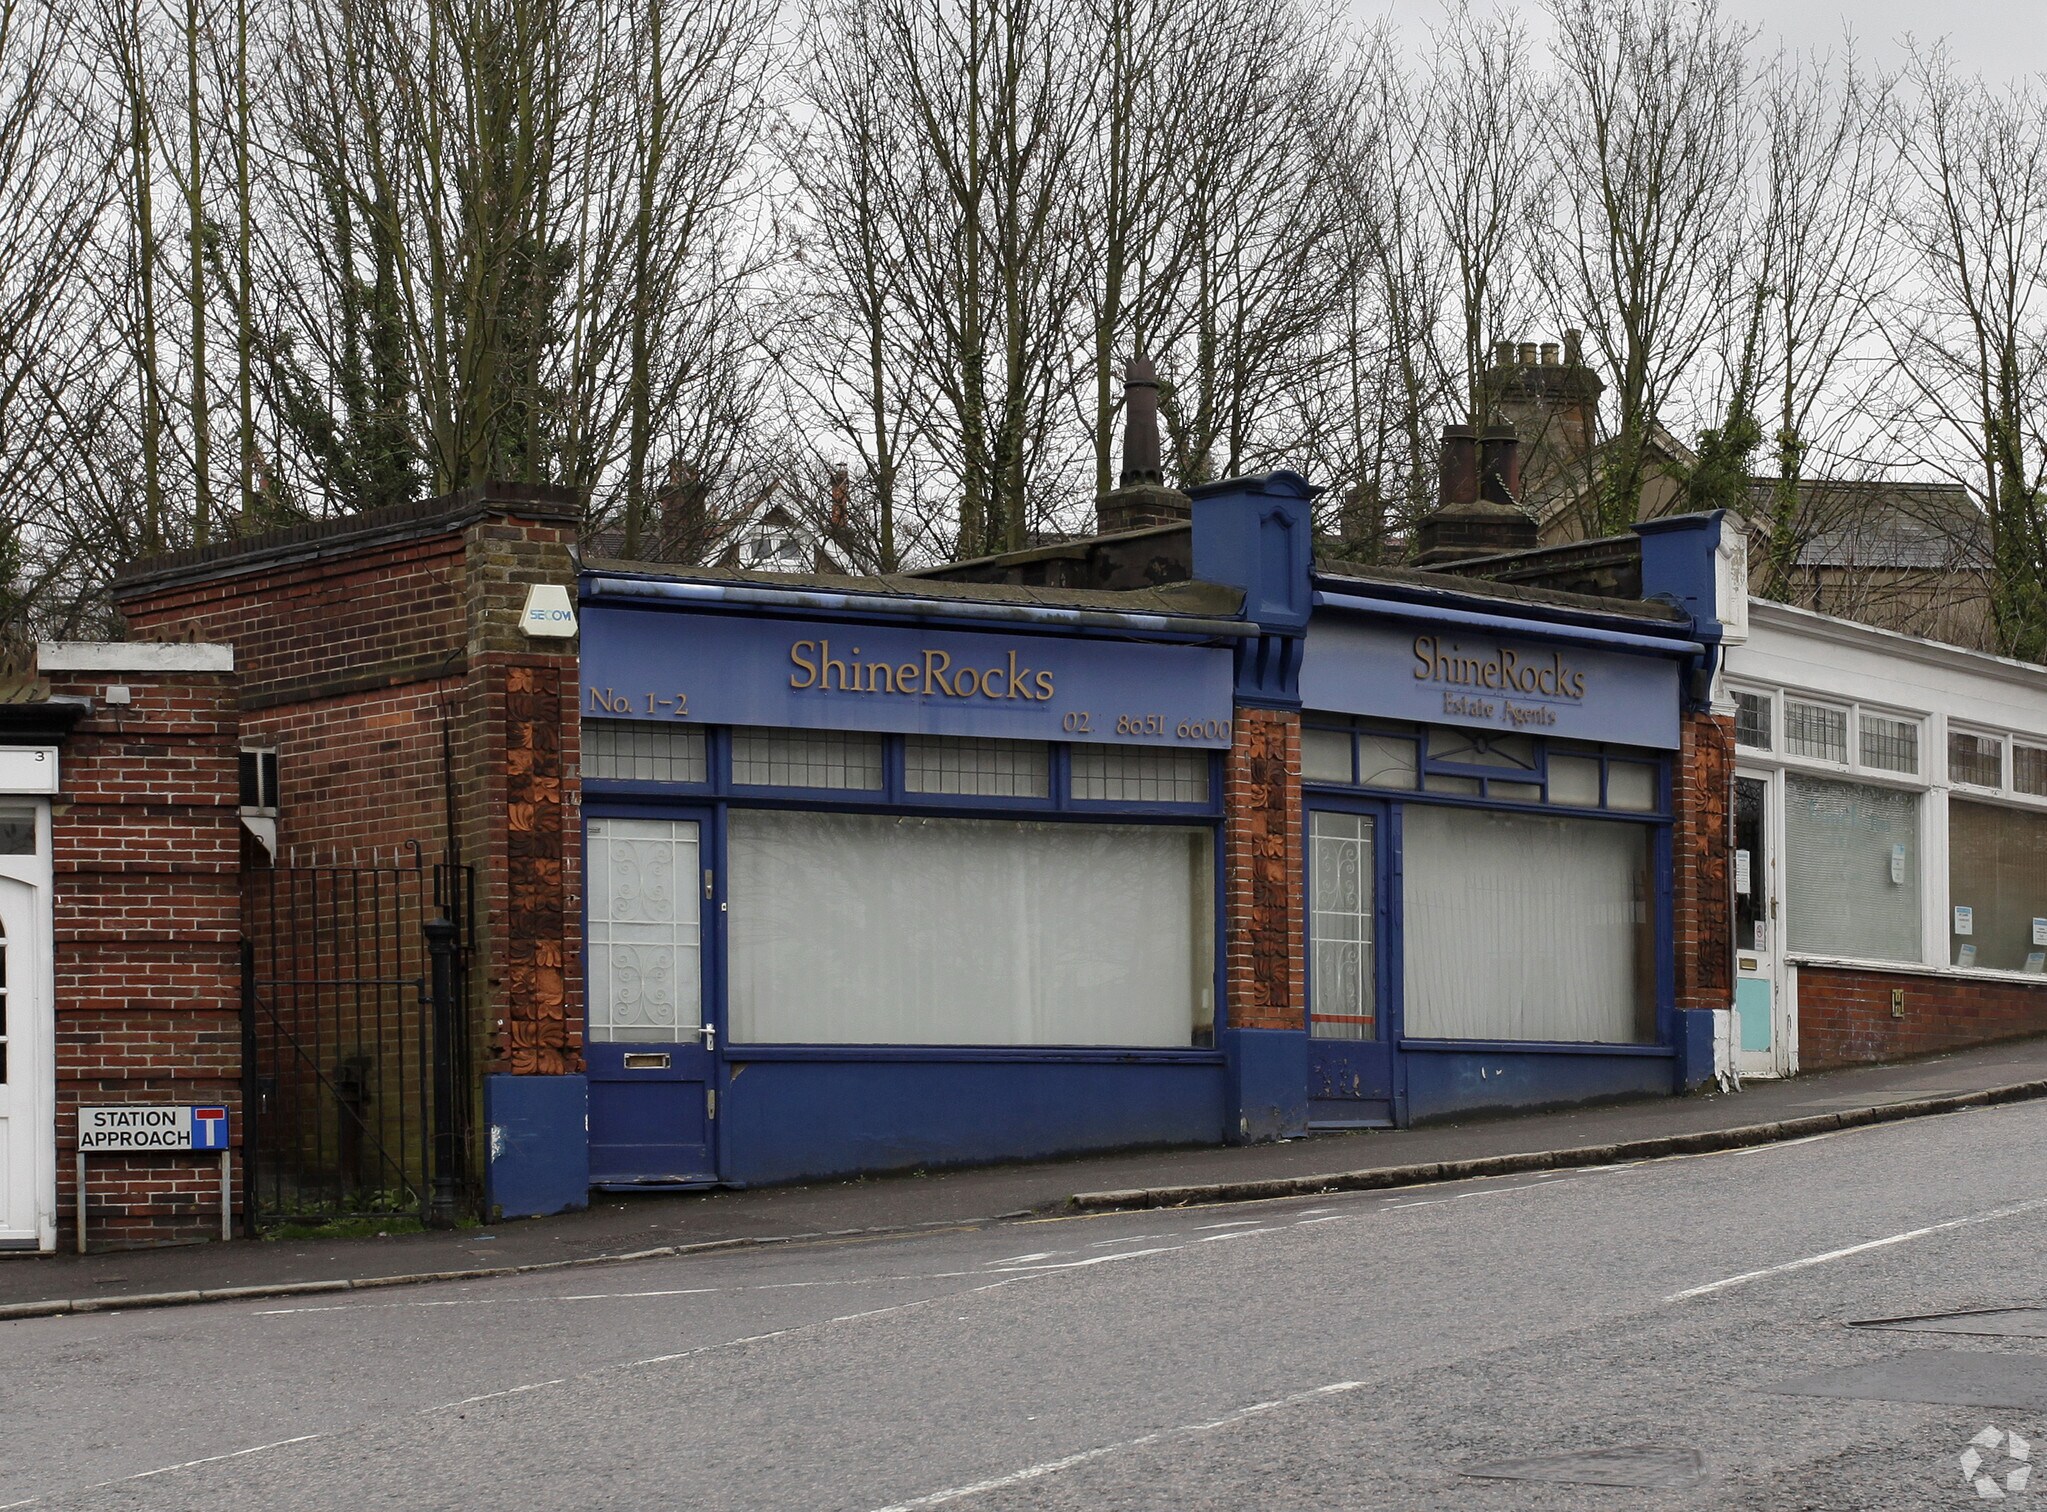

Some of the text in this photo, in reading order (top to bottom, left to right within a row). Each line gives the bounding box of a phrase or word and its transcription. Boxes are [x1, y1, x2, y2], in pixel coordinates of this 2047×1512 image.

[530, 609, 571, 621] SECOM
[790, 639, 1055, 700] ShineRocks
[1413, 635, 1586, 699] ShineRocks
[589, 687, 689, 715] No. 1-2
[1116, 713, 1166, 735] 8651
[1176, 717, 1232, 740] 6600
[34, 750, 45, 762] 3
[94, 1111, 177, 1127] STATION
[81, 1130, 191, 1147] APPROACH
